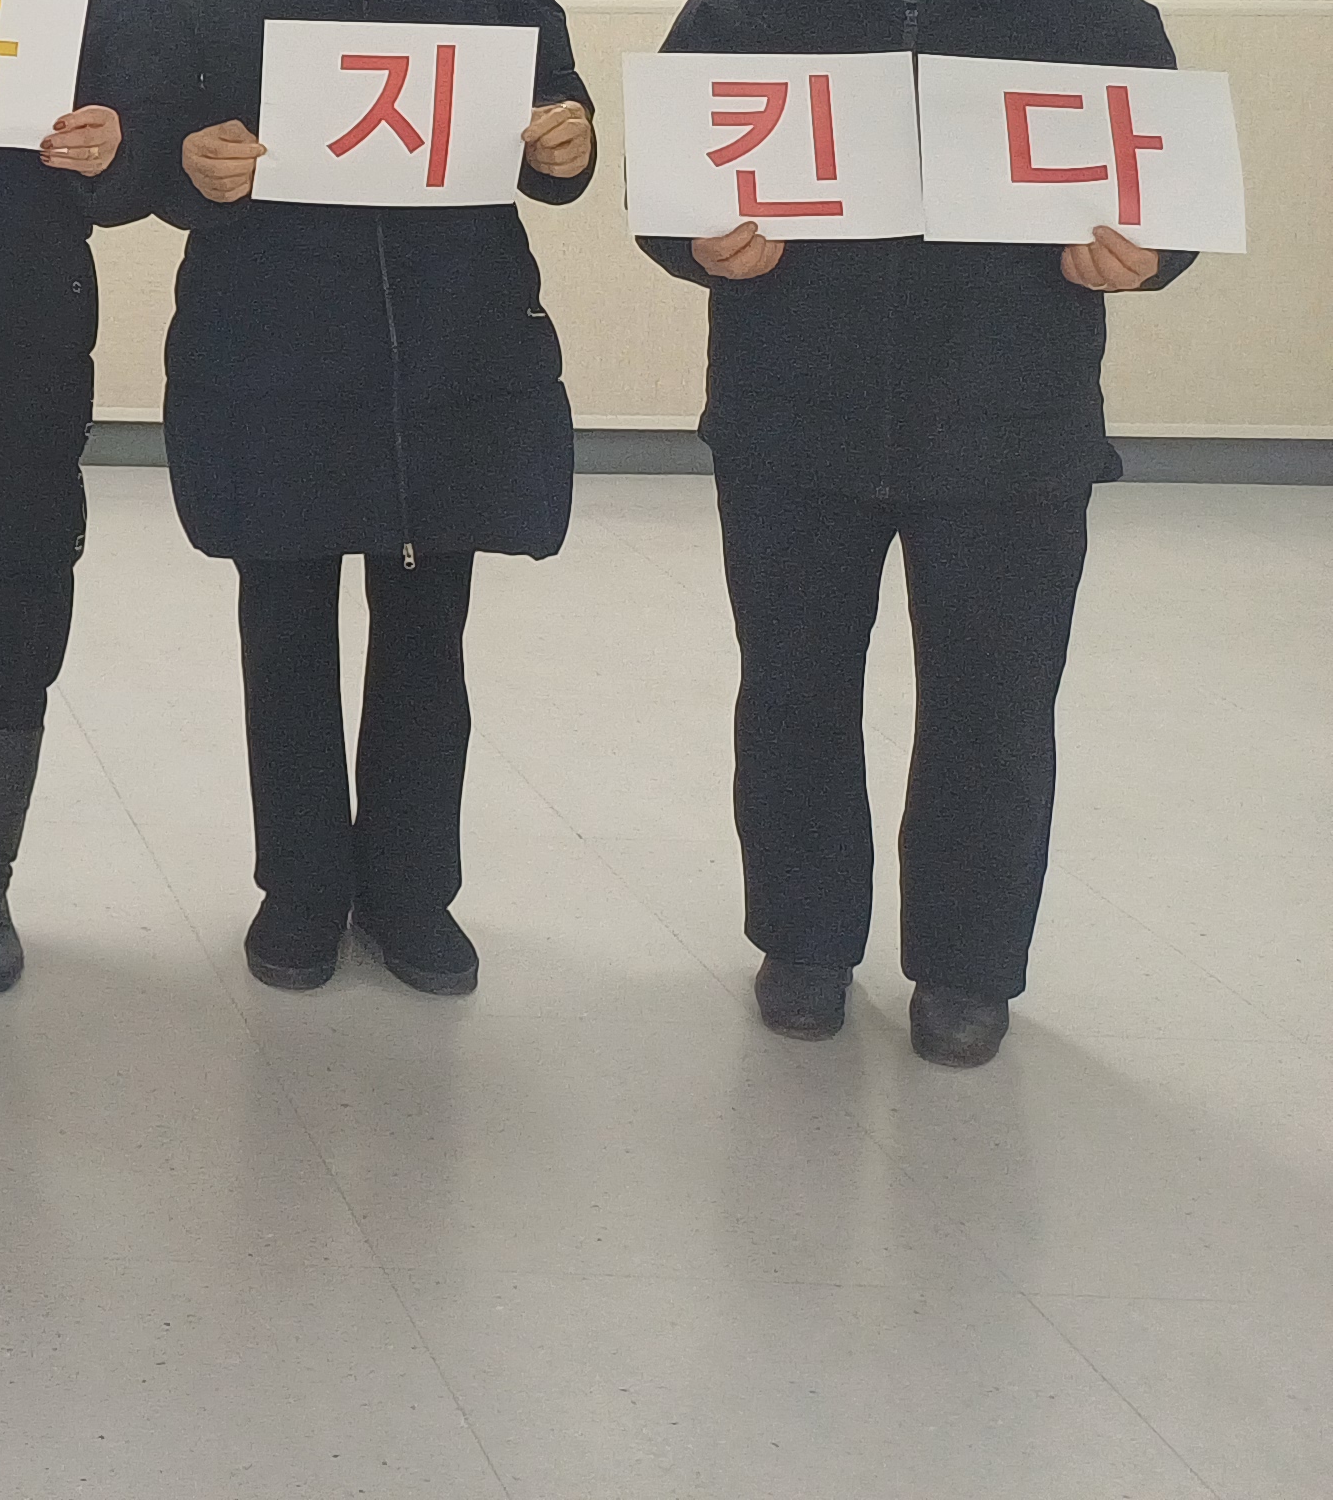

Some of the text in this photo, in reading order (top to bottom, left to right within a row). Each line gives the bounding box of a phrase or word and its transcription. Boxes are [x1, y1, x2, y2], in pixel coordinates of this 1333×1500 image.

[326, 43, 457, 189] 지
[706, 73, 845, 218] 킨
[1003, 84, 1165, 226] 다
